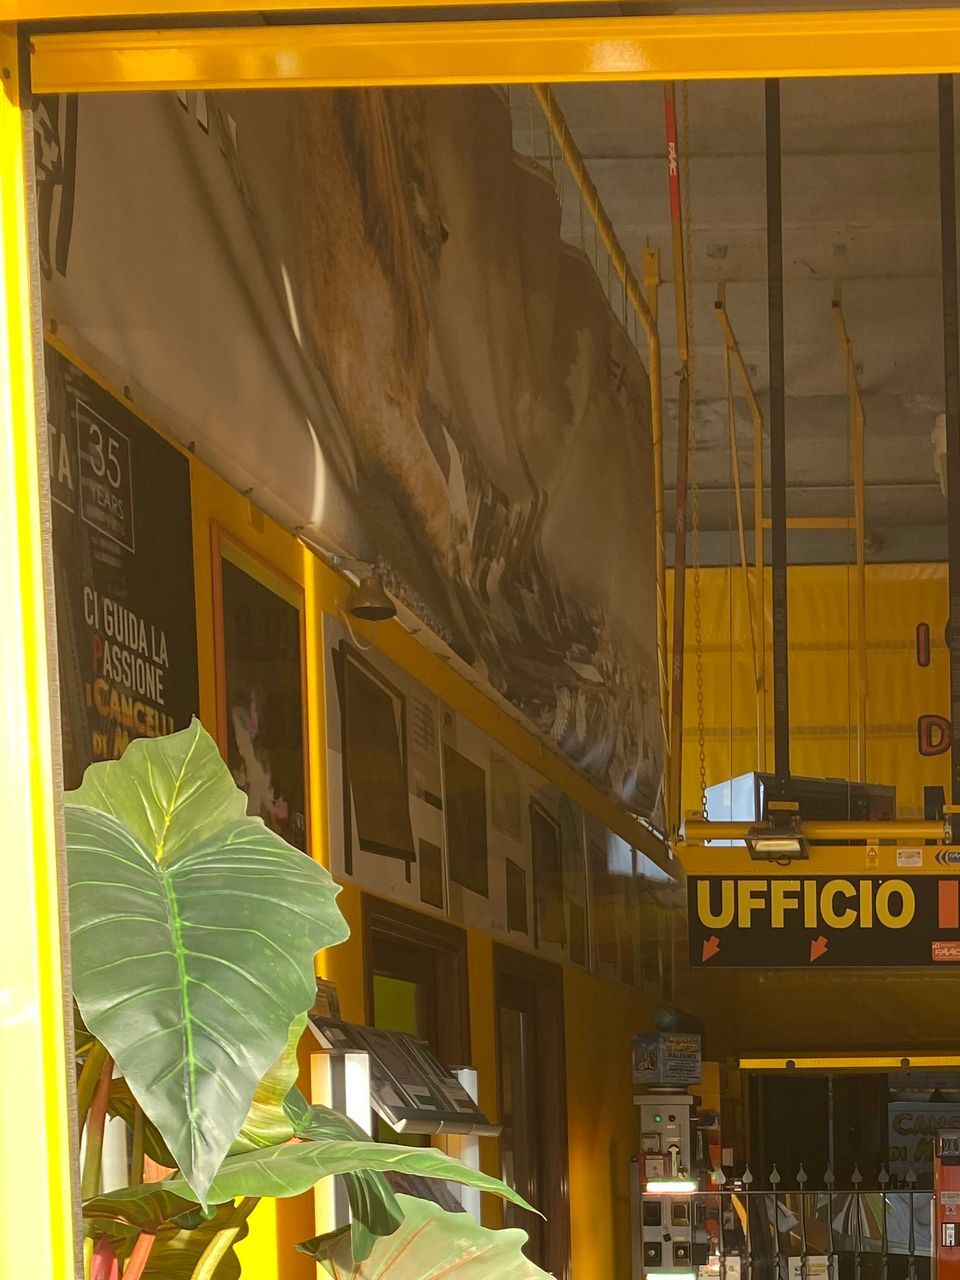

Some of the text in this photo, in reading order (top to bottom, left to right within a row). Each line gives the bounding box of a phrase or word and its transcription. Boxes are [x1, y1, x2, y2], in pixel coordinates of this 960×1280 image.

[88, 423, 122, 489] 35
[89, 480, 126, 520] YEARS
[83, 586, 169, 668] CI GUIDA LA
[916, 622, 931, 667] I
[92, 633, 165, 705] PASSIONE
[697, 879, 915, 929] UFFICIO
